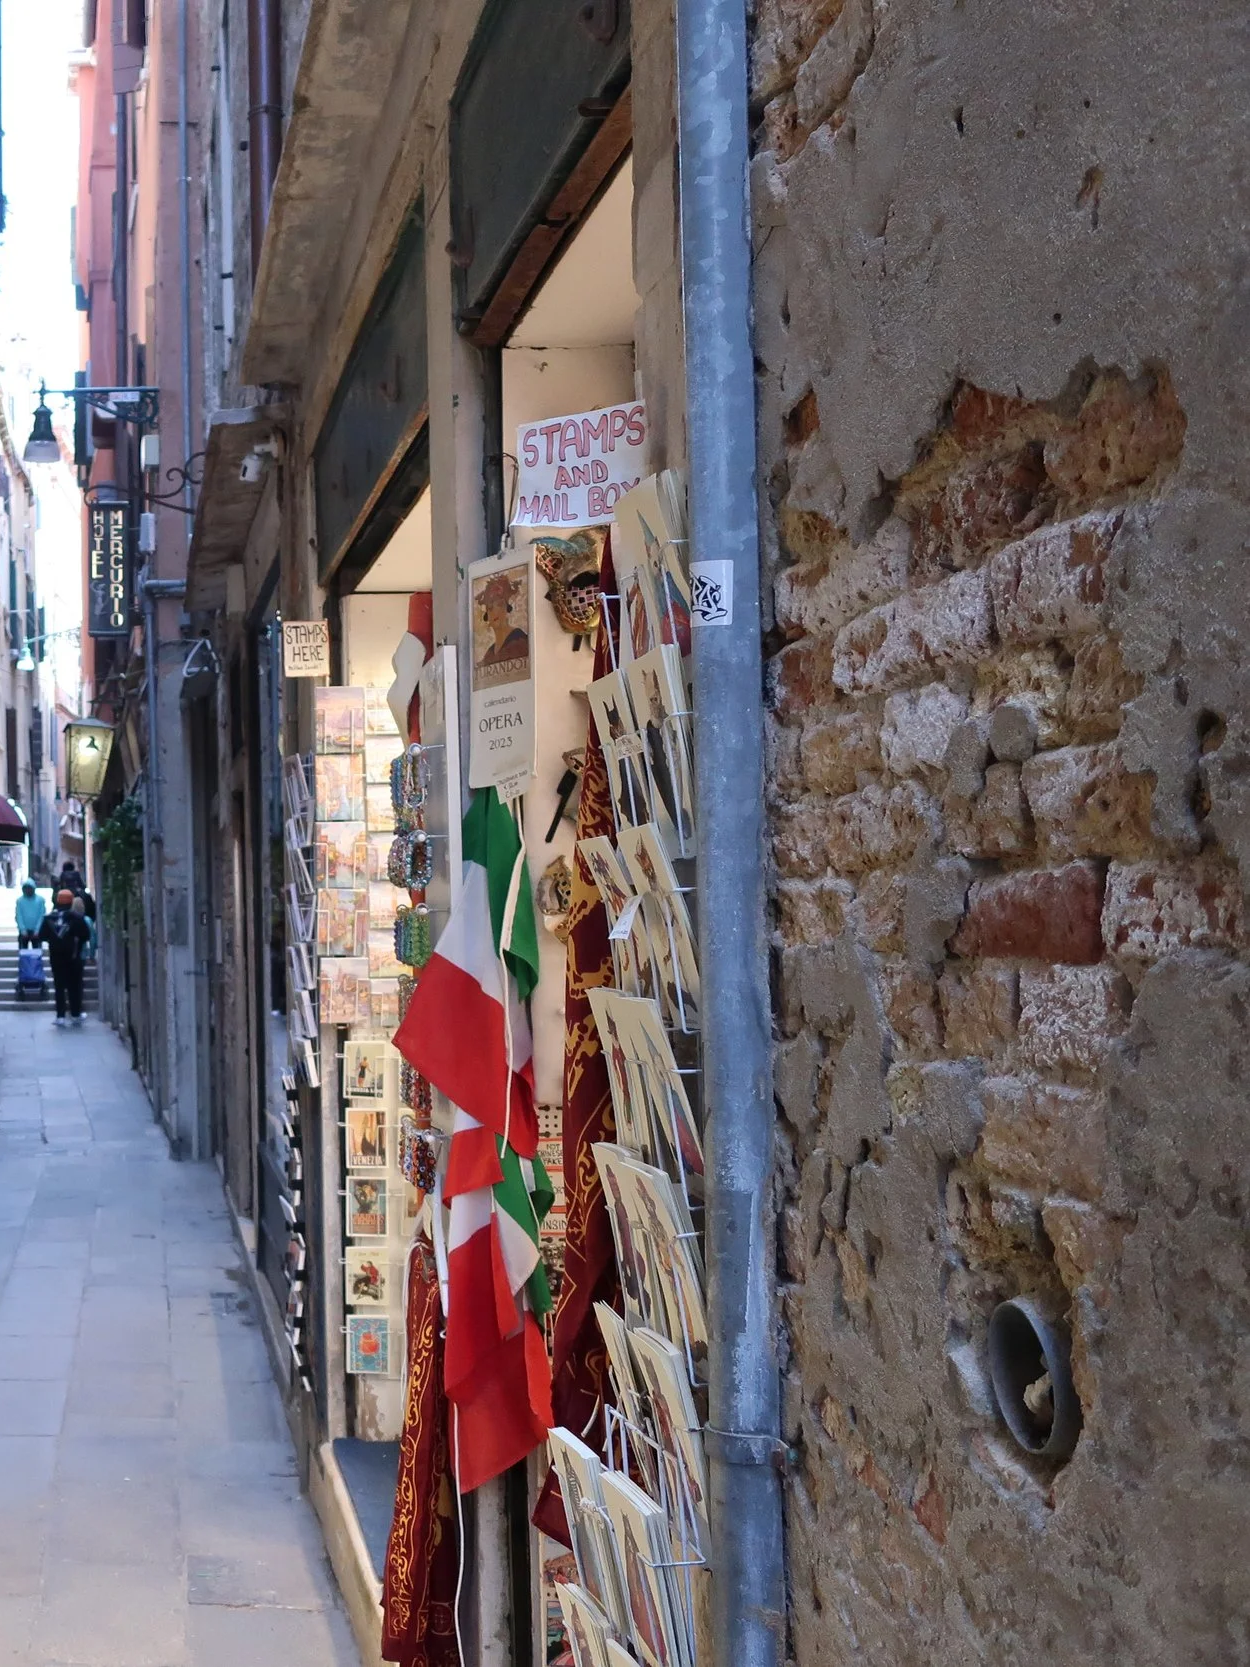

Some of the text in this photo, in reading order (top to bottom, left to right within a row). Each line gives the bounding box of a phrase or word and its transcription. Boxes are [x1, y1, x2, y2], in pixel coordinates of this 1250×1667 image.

[523, 405, 645, 467] STAMPS
[554, 459, 608, 490] AND
[517, 493, 578, 524] MAIL
[92, 510, 104, 579] HOTEL
[109, 510, 123, 627] MERCURIO
[286, 624, 328, 645] STAMPS
[293, 645, 324, 662] HERE
[474, 657, 528, 681] TURANDOT
[479, 712, 523, 733] OPERA
[489, 737, 512, 750] 2023
